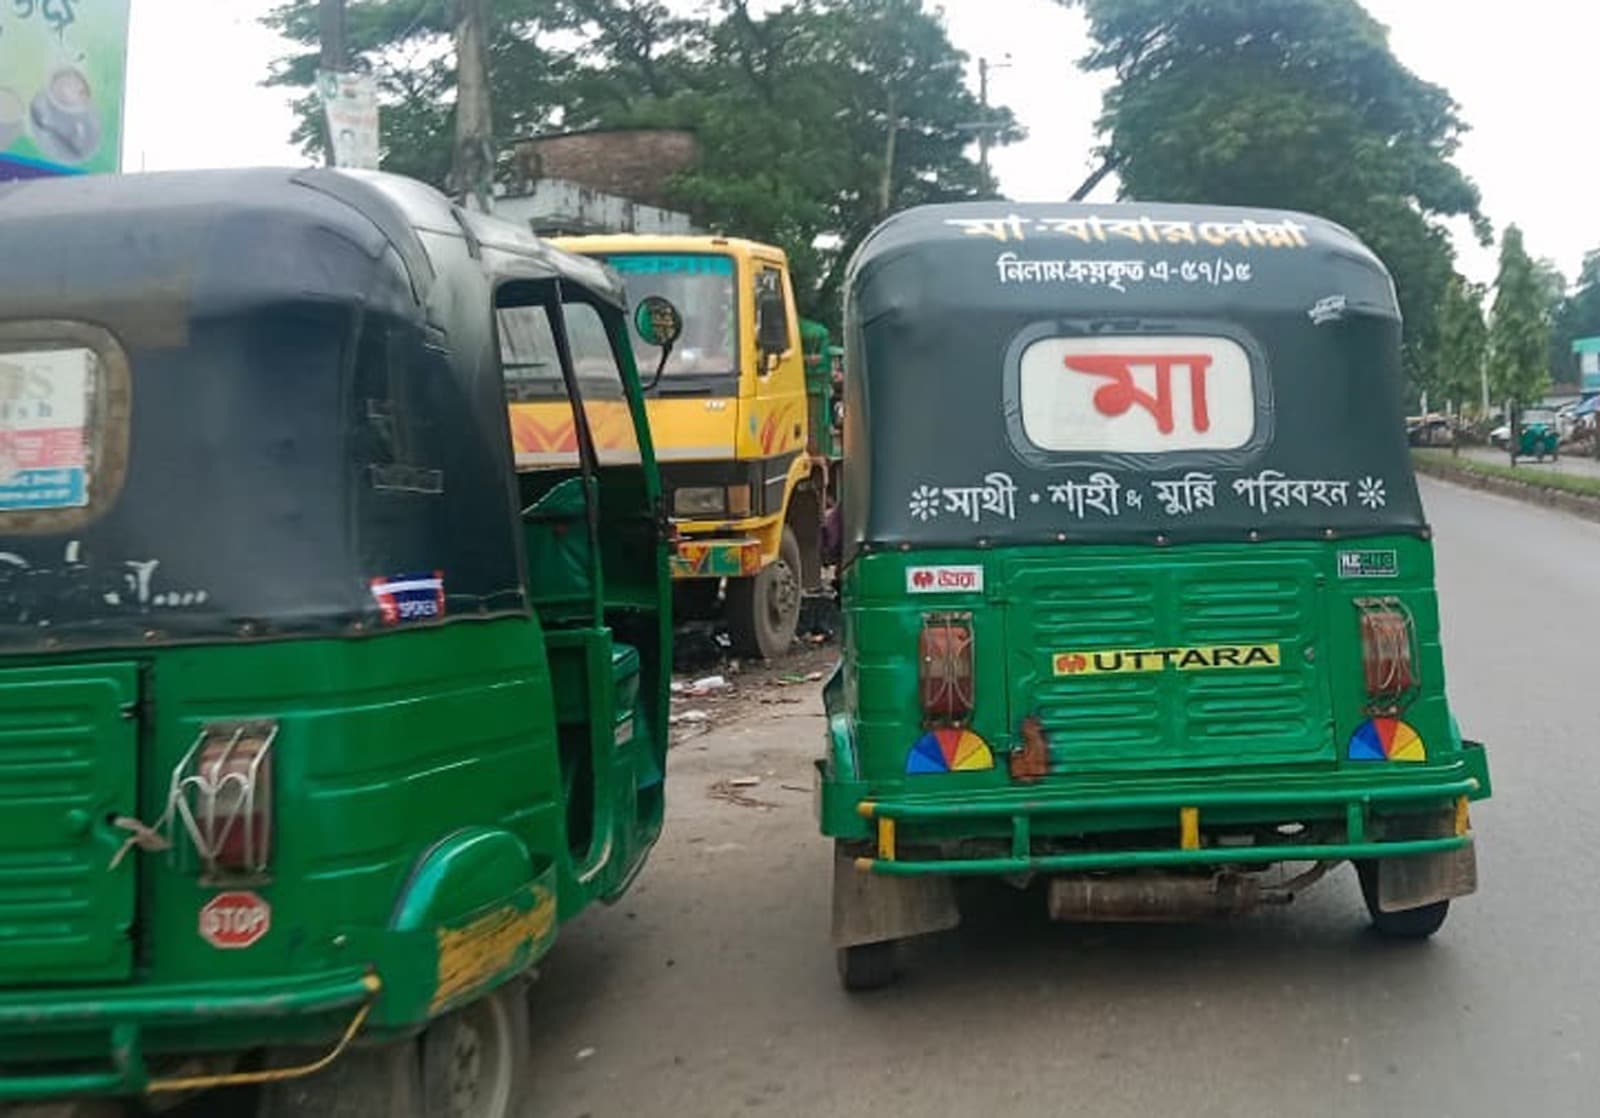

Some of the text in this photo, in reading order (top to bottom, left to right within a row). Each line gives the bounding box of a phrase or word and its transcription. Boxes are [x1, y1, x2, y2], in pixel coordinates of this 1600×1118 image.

[1063, 354, 1213, 435] মা
[942, 472, 1018, 522] সাথী
[1047, 472, 1120, 519] শাহী
[1151, 472, 1217, 515] মুন্নি
[1232, 470, 1350, 514] পরিবহন
[1094, 646, 1275, 671] UTTARA
[201, 907, 265, 933] STOP
